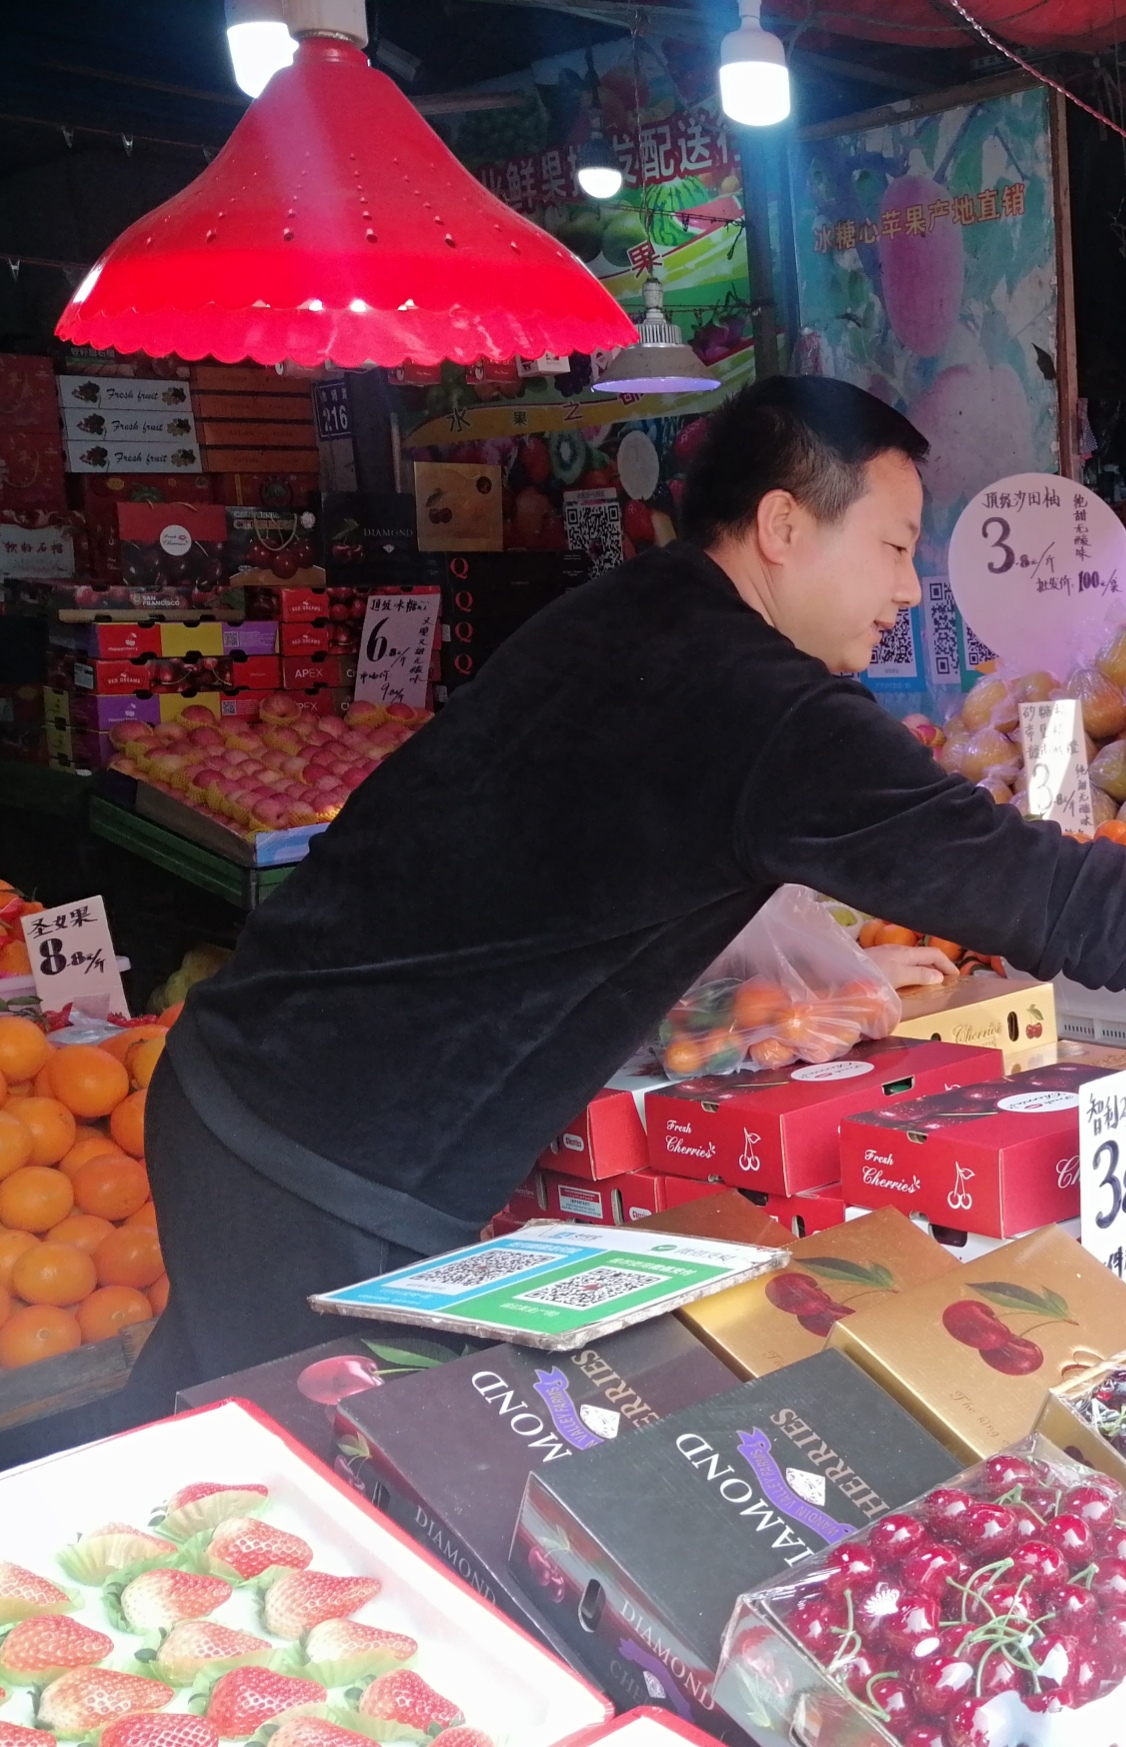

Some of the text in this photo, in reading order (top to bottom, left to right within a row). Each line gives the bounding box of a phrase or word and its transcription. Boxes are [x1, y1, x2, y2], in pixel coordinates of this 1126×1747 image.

[813, 183, 1026, 253] 冰糖心苹果产地直销
[106, 388, 158, 401] Fresh fruit
[111, 420, 163, 433] Fresh fruit
[322, 404, 348, 432] 216
[114, 452, 167, 464] Fresh fruit
[363, 528, 414, 537] DIAMOND
[450, 557, 469, 579] Q
[455, 591, 473, 613] Q
[455, 622, 473, 643] Q
[294, 667, 323, 679] APEX
[454, 654, 473, 675] Q
[27, 904, 98, 940] 圣女果
[666, 1119, 692, 1135] Fresh
[665, 1134, 716, 1159] Cherries
[864, 1149, 894, 1166] Fresh
[862, 1166, 921, 1194] Cherries
[570, 1349, 661, 1430] ERRIES
[471, 1370, 573, 1463] MOND
[546, 1386, 588, 1443] VALLEY FARMS
[949, 1390, 976, 1415] The
[977, 1414, 1000, 1439] king
[769, 1408, 891, 1519] HERRIES
[675, 1433, 816, 1568] IAMOND
[750, 1448, 840, 1537] WANDIN VALLEY FARMS
[415, 1505, 496, 1606] DIAMOND
[619, 1597, 715, 1711] DIAMOND
